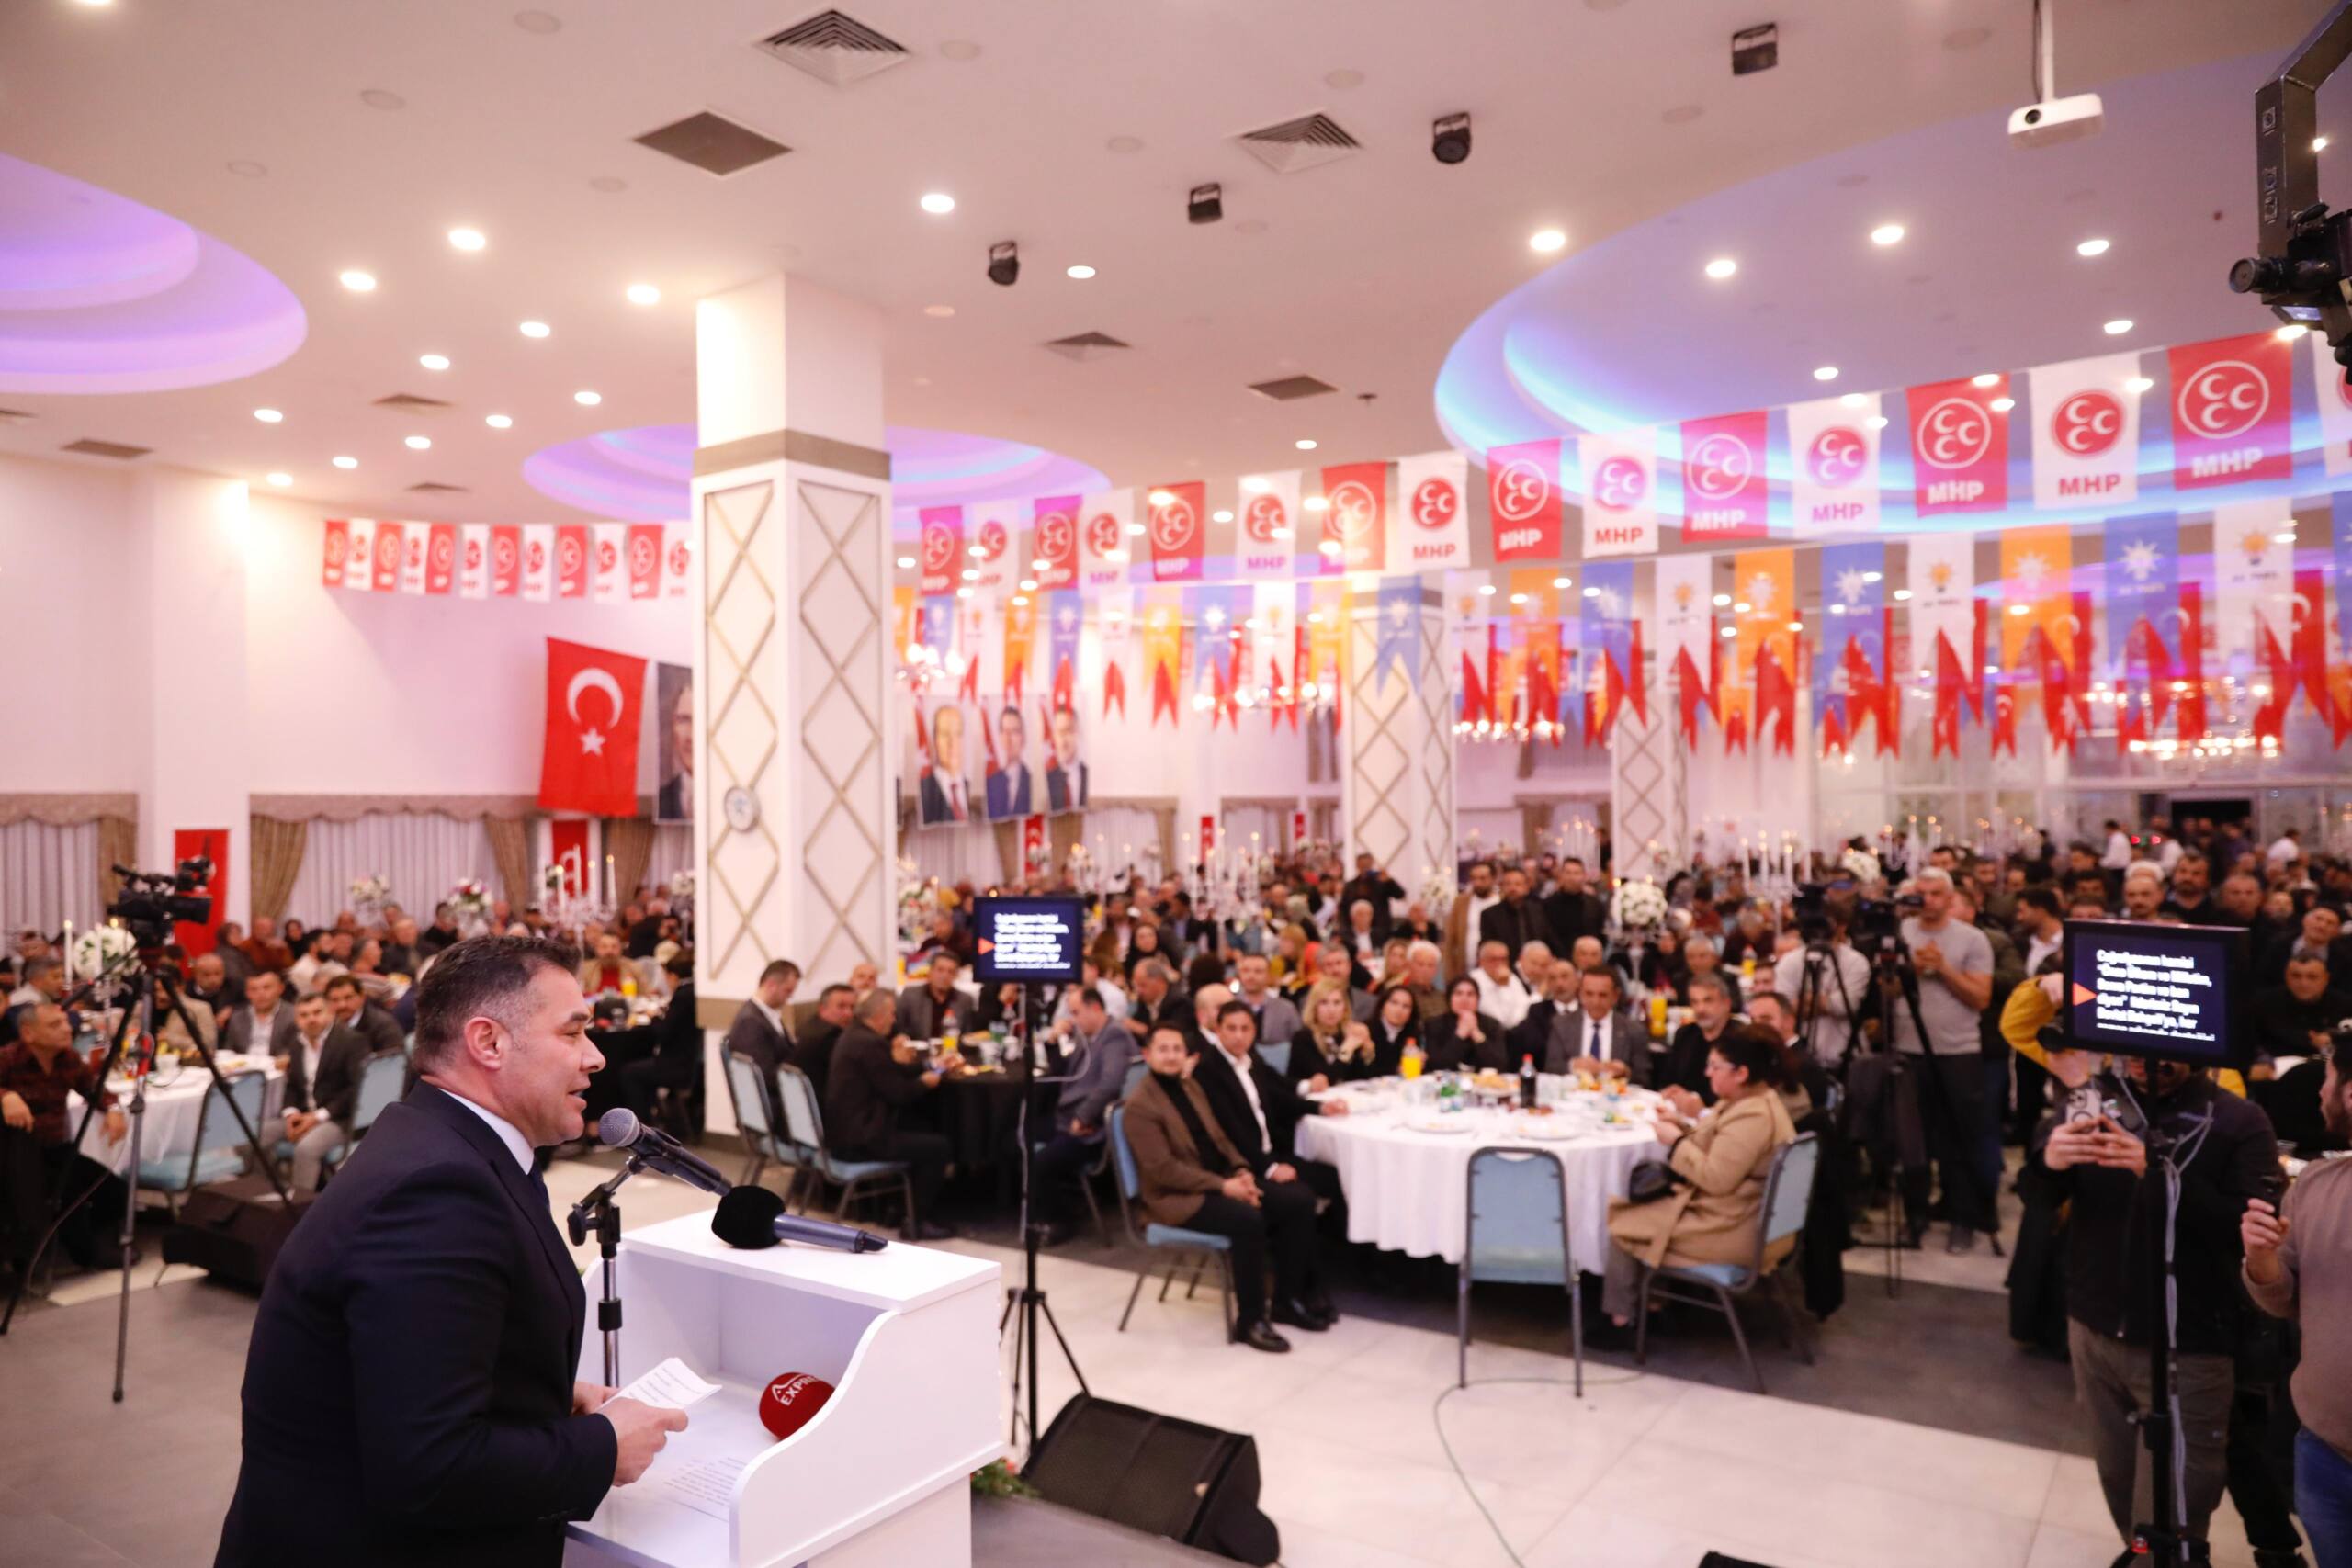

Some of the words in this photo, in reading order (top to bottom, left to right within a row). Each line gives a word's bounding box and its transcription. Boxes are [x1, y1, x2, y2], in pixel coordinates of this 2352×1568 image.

[2192, 446, 2263, 478] MHP
[1928, 480, 1984, 504] MHP
[2058, 474, 2121, 496] MHP
[1691, 509, 1746, 531] MHP
[1812, 502, 1863, 522] MHP
[1499, 528, 1543, 551] MHP
[1594, 527, 1644, 544] MHP
[1413, 544, 1456, 559] MHP
